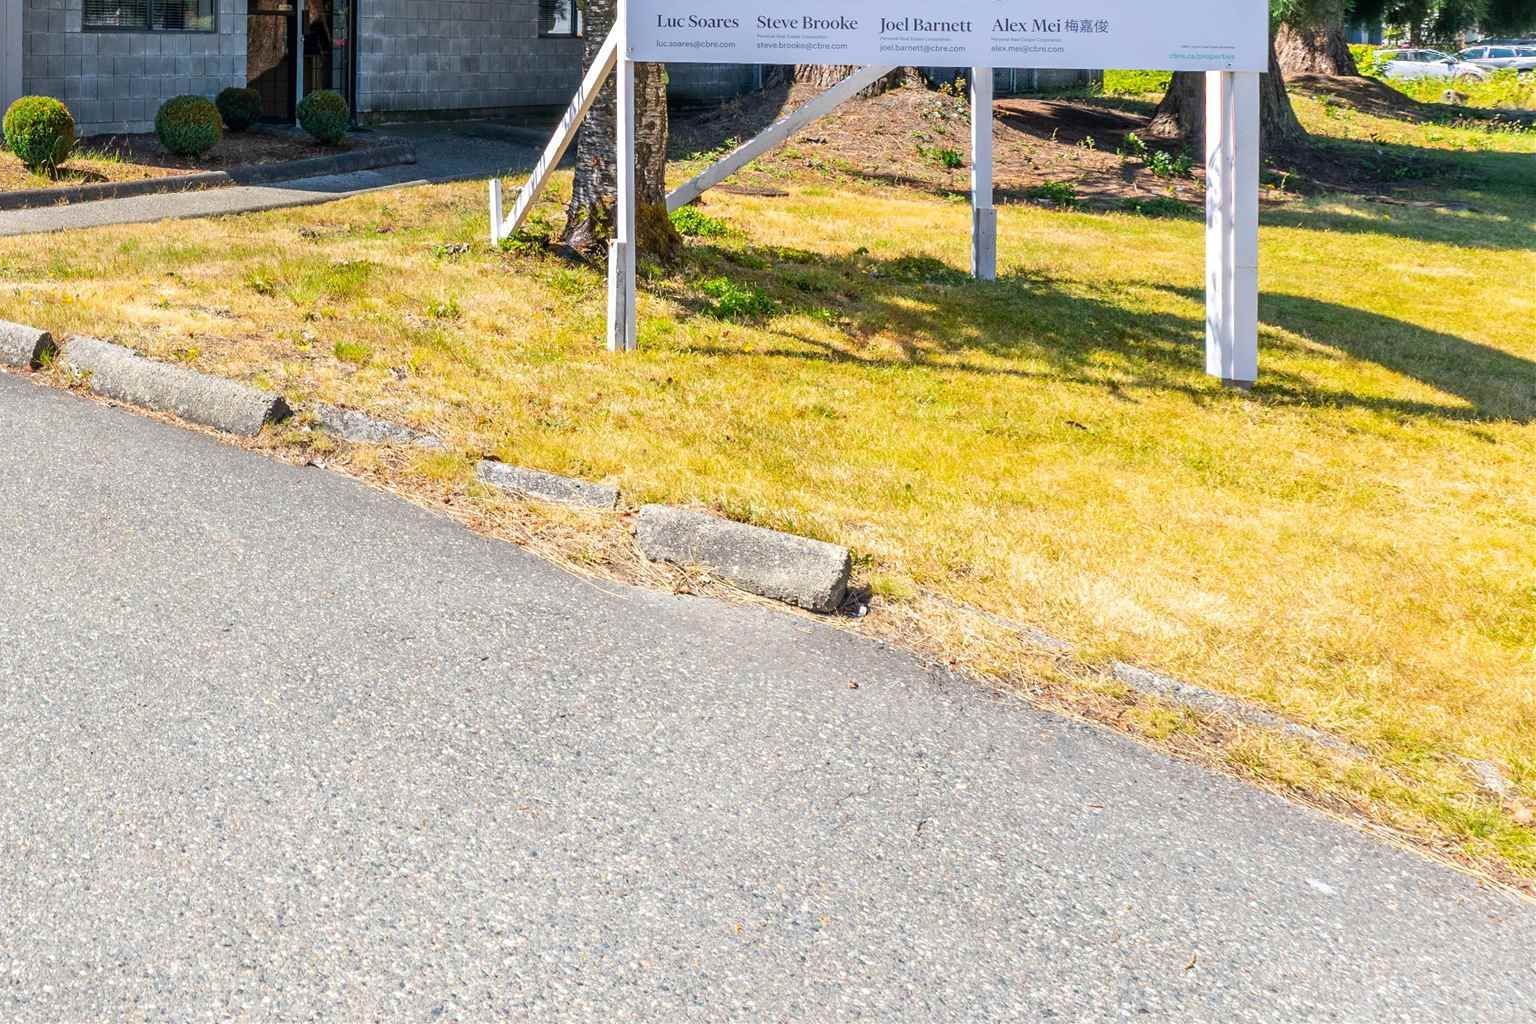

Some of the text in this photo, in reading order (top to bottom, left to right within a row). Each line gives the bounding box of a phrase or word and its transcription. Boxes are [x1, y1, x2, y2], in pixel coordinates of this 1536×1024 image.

[656, 14, 740, 29] Luc Soares
[755, 15, 859, 31] Steve Brooke
[879, 17, 973, 34] Joel Barnett
[991, 18, 1028, 33] Alex
[1030, 18, 1062, 33] Mei
